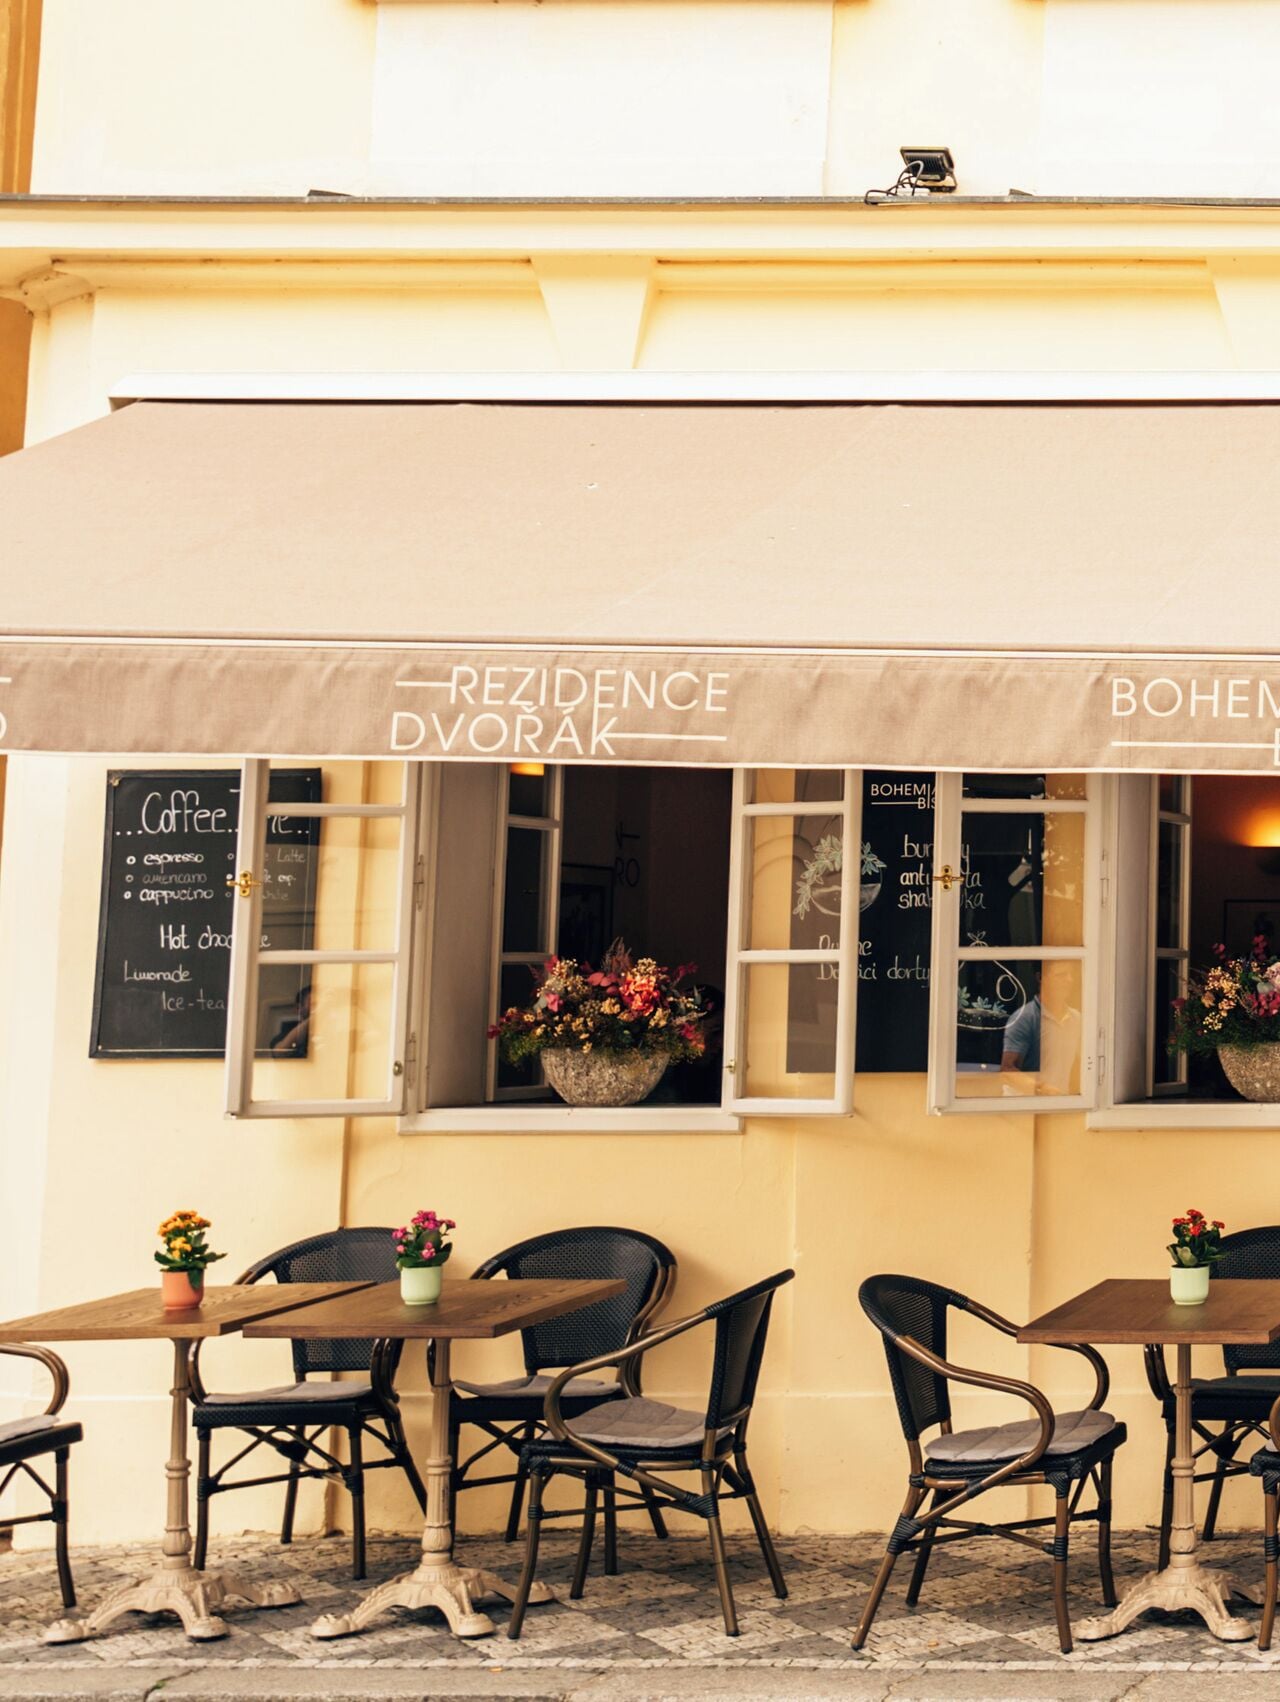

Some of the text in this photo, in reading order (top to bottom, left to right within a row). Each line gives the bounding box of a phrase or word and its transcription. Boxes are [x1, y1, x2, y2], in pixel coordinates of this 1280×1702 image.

[450, 665, 730, 712] REZIDENCE
[390, 705, 618, 756] DVOŘÁK
[871, 783, 935, 796] BOHEMI
[143, 853, 204, 874] espresso
[160, 924, 190, 949] Hot
